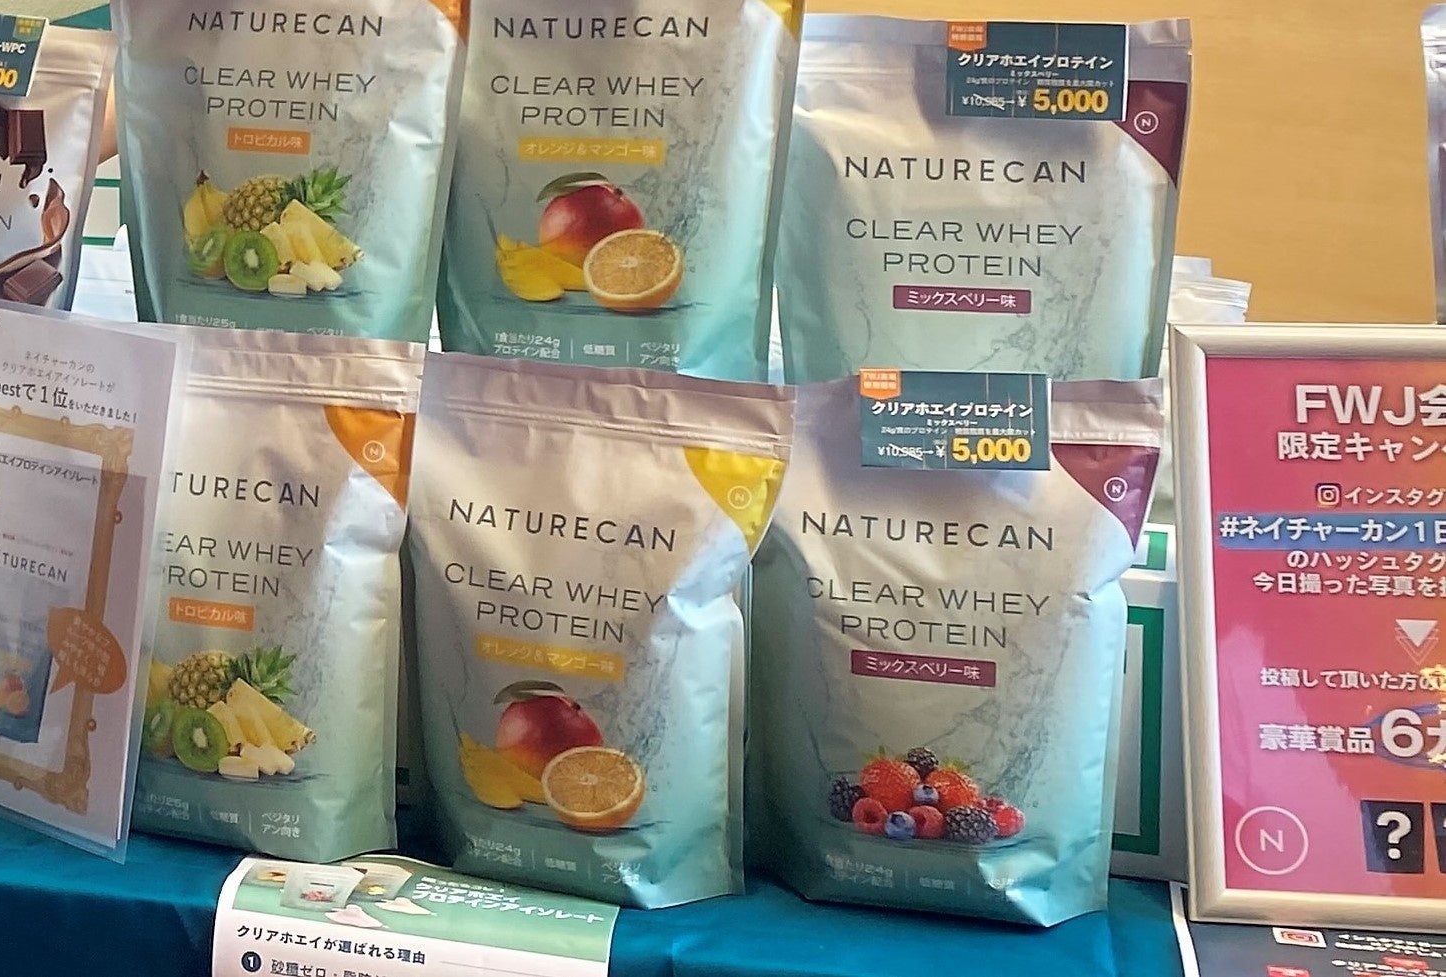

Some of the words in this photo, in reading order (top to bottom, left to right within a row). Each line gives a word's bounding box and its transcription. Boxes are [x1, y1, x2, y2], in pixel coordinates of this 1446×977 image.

[188, 10, 383, 37] NATURECAN
[493, 17, 709, 39] NATURECAN
[958, 52, 1113, 69] クリアホエイプロテイン
[184, 66, 275, 89] CLEAR
[286, 70, 376, 93] WHEY
[490, 75, 595, 96] CLEAR
[607, 77, 705, 97] WHEY
[206, 96, 339, 122] PROTEIN
[1033, 87, 1109, 115] 5,000
[521, 106, 666, 128] PROTEIN
[232, 132, 304, 149] トロピカル味
[845, 156, 1086, 184] NATURECAN
[846, 218, 963, 243] CLEAR
[976, 223, 1082, 245] WHEY
[883, 252, 1042, 277] PROTEIN
[906, 290, 1016, 308] ミックスベリー味
[871, 402, 1033, 417] クリアホエイプロテイン
[926, 418, 978, 427] ミックスベリー
[952, 437, 1031, 464] 5,000
[1277, 431, 1446, 463] 限定キャン
[449, 498, 676, 552] NATURECAN
[802, 510, 1053, 551] NATURECAN
[227, 539, 313, 567] WHEY
[163, 565, 279, 597] ROTEIN
[445, 563, 553, 600] CLEAR
[565, 580, 664, 615] WHEY
[806, 576, 925, 608] CLEAR
[938, 587, 1050, 617] WHEY
[476, 601, 625, 644] PROTEIN
[841, 614, 1007, 648] PROTEIN
[866, 660, 981, 680] ミックスベリー味
[412, 890, 604, 923] プロテインアイソレート
[237, 925, 426, 965] クリアホエイが選ばれる理由
